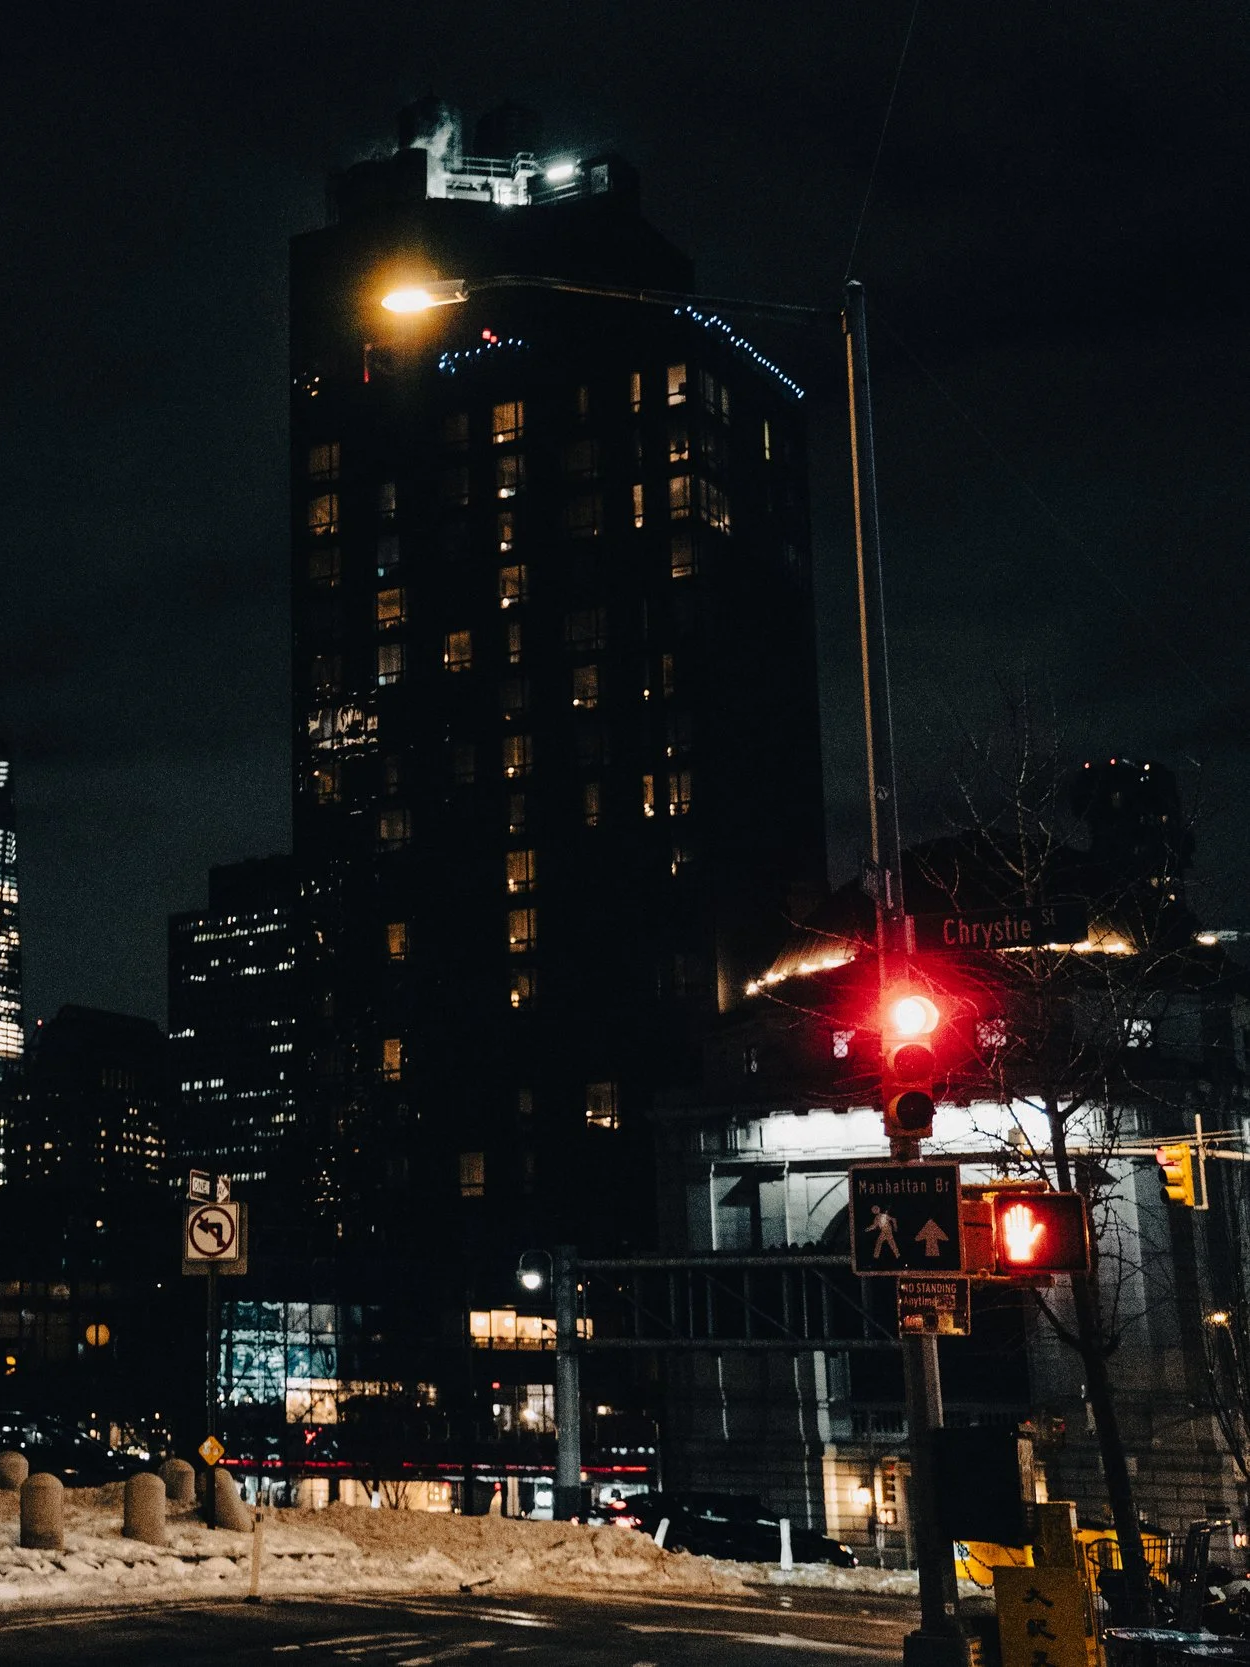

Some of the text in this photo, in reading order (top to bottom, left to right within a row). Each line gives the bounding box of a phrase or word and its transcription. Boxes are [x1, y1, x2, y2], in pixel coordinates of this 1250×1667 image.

[942, 908, 1056, 949] Chrystie St
[858, 1177, 950, 1195] Manhattan Br
[902, 1282, 957, 1294] NO STANDING
